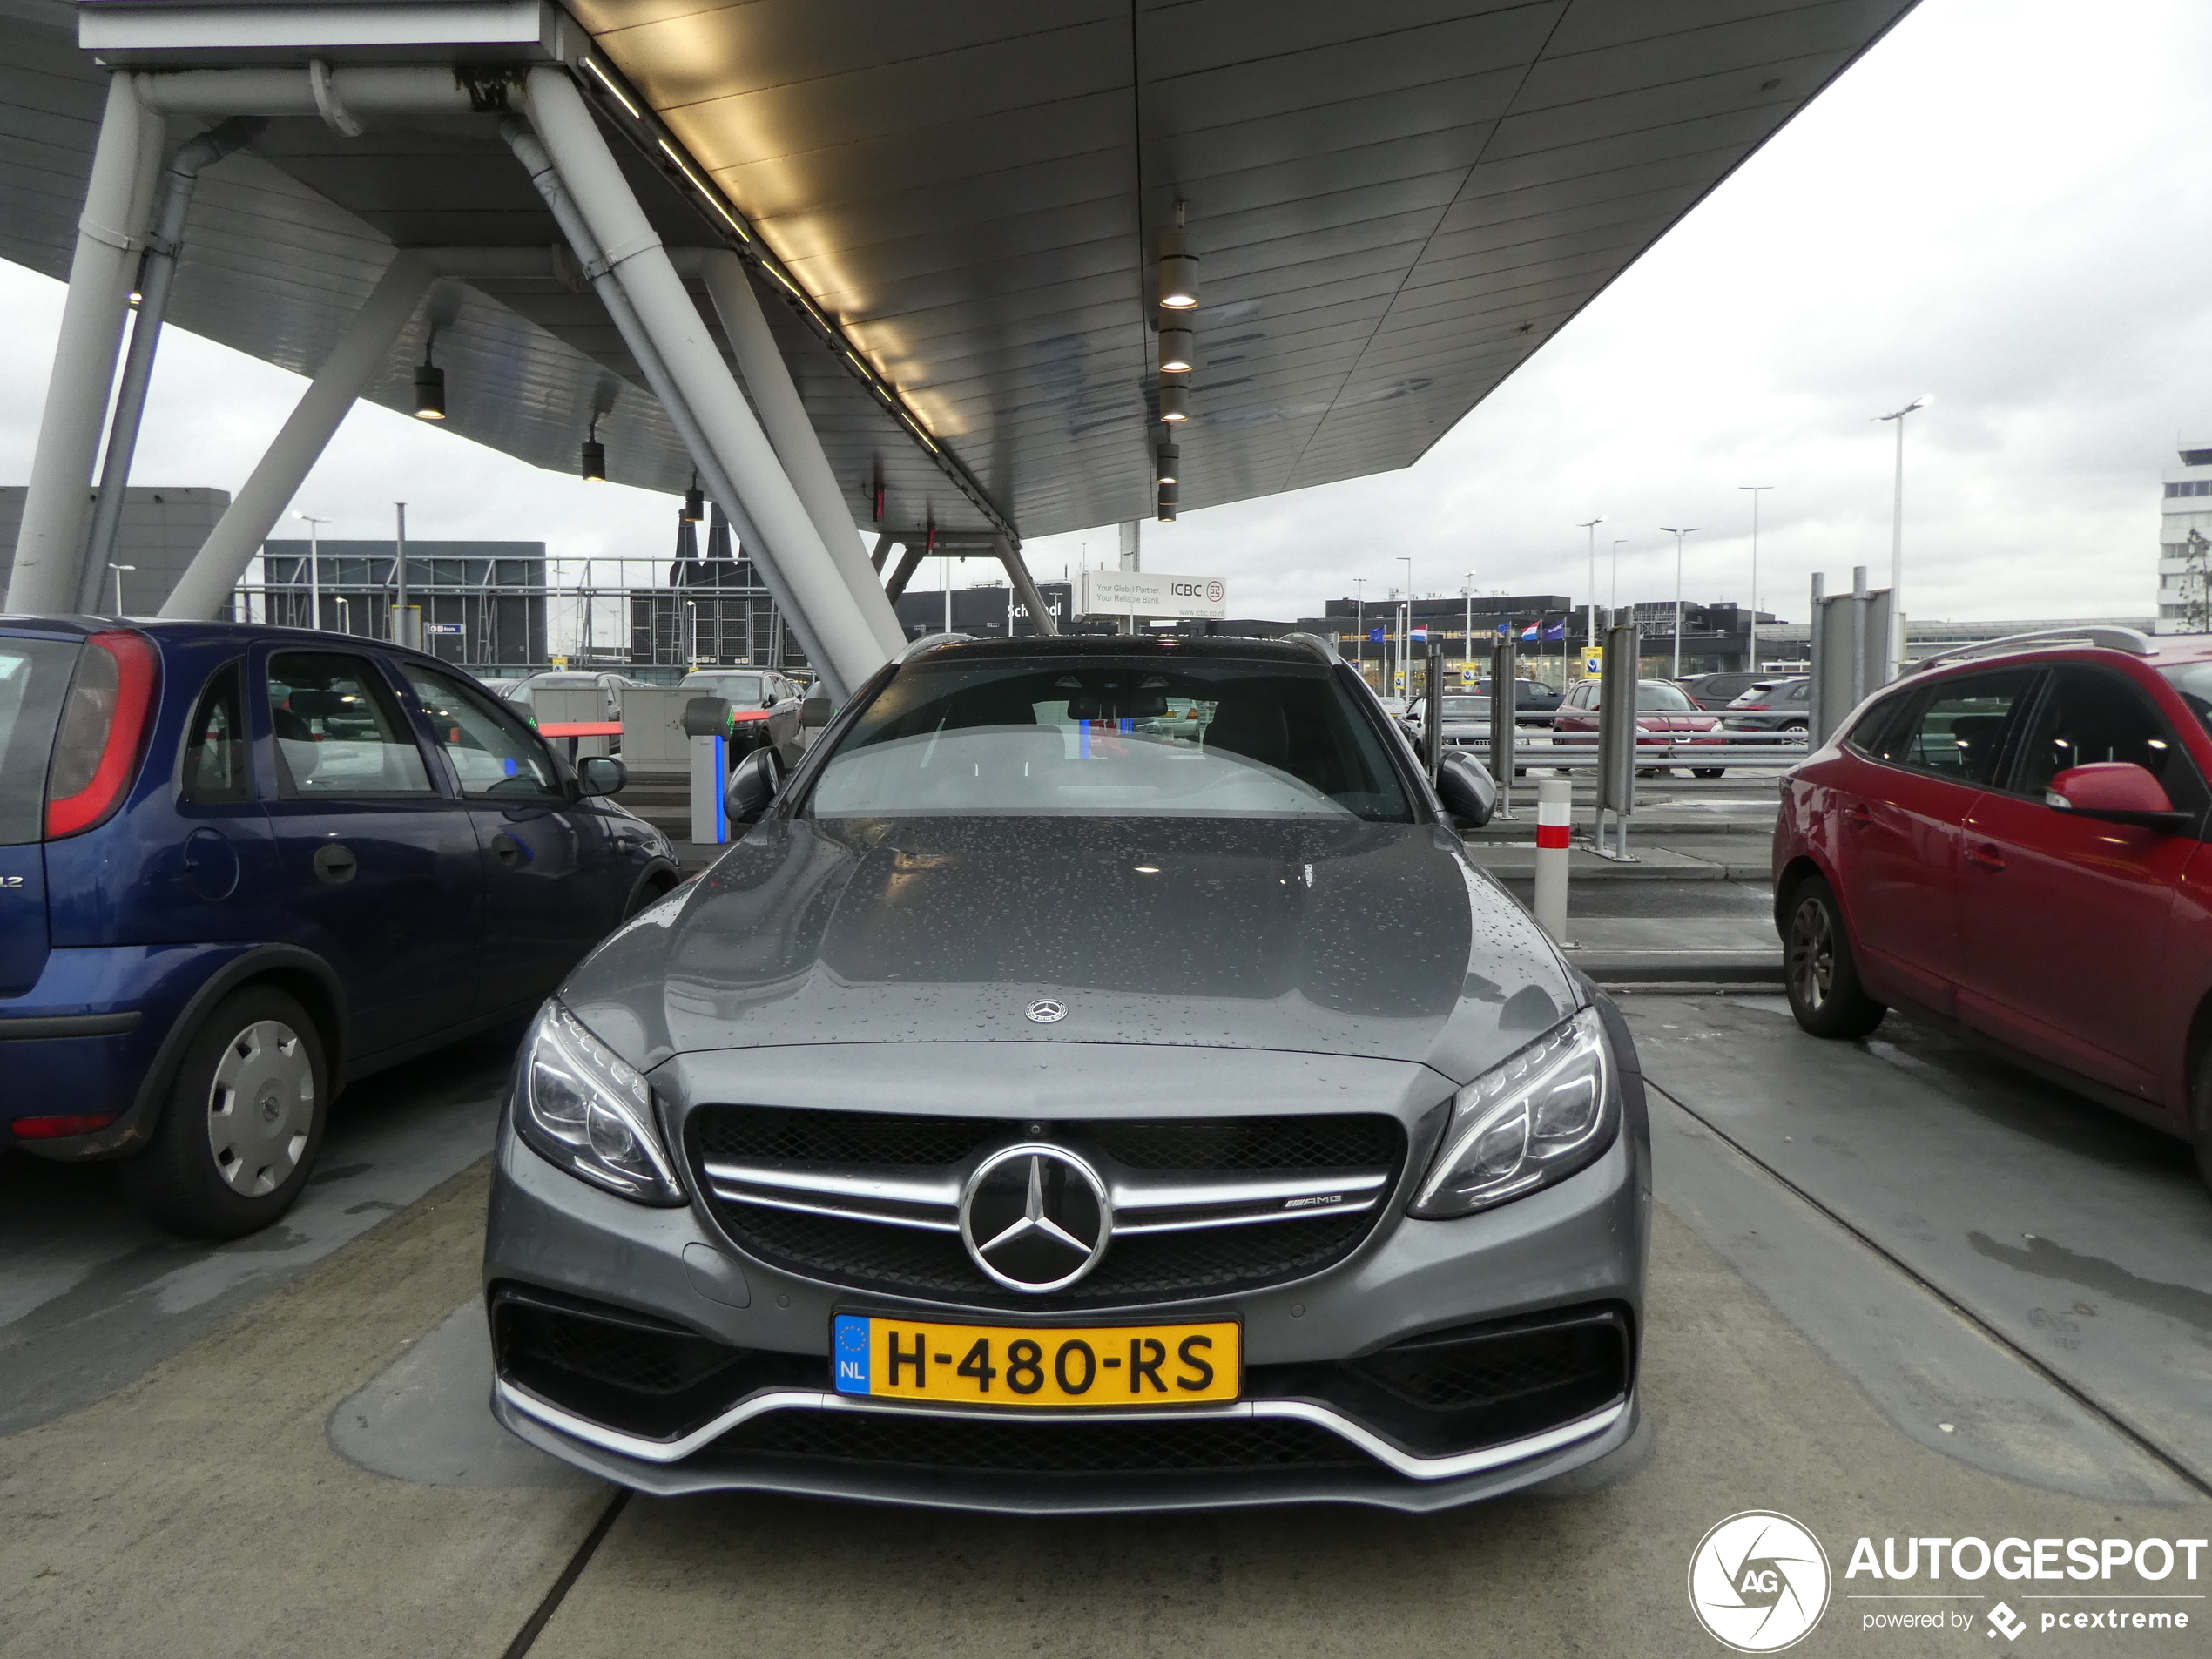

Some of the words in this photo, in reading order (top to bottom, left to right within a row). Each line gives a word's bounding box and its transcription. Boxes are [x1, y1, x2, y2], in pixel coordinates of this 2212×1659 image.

[1096, 583, 1112, 592] Your
[1170, 583, 1202, 597] ICBC
[1143, 596, 1161, 604] Bank.
[1008, 602, 1061, 617] Schol
[1178, 609, 1224, 617] www.icbc.co.nl
[1304, 1195, 1341, 1205] AMG
[887, 1330, 1215, 1394] H-480-RS
[840, 1361, 865, 1379] NL
